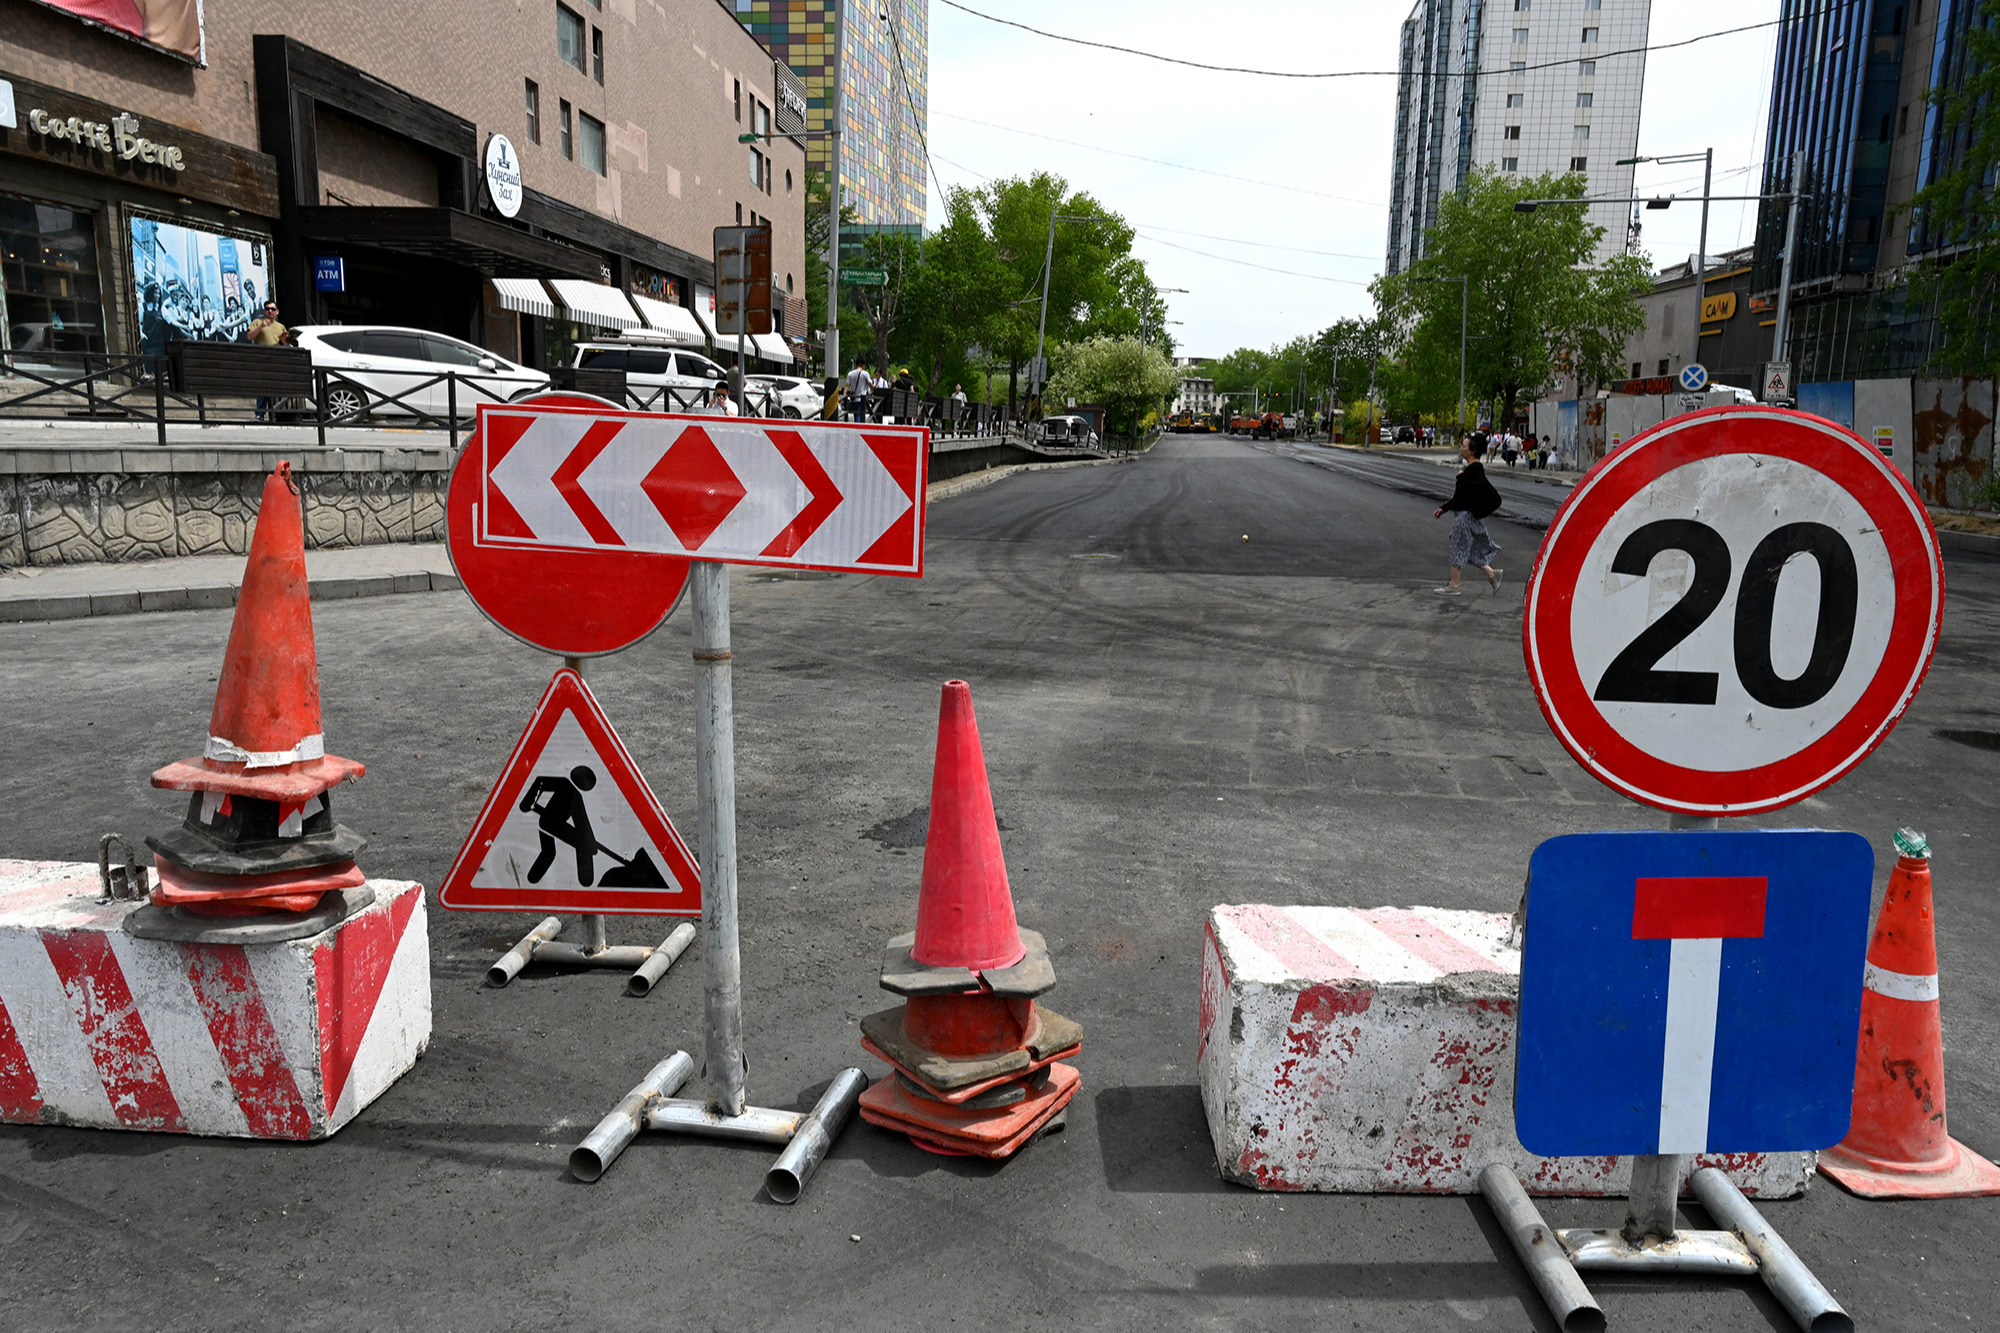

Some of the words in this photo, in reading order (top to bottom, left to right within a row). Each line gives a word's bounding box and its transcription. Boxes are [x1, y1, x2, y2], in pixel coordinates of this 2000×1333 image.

[111, 113, 186, 171] bene
[498, 182, 513, 201] Зах
[317, 269, 339, 281] ATM
[1592, 517, 1859, 710] 20
